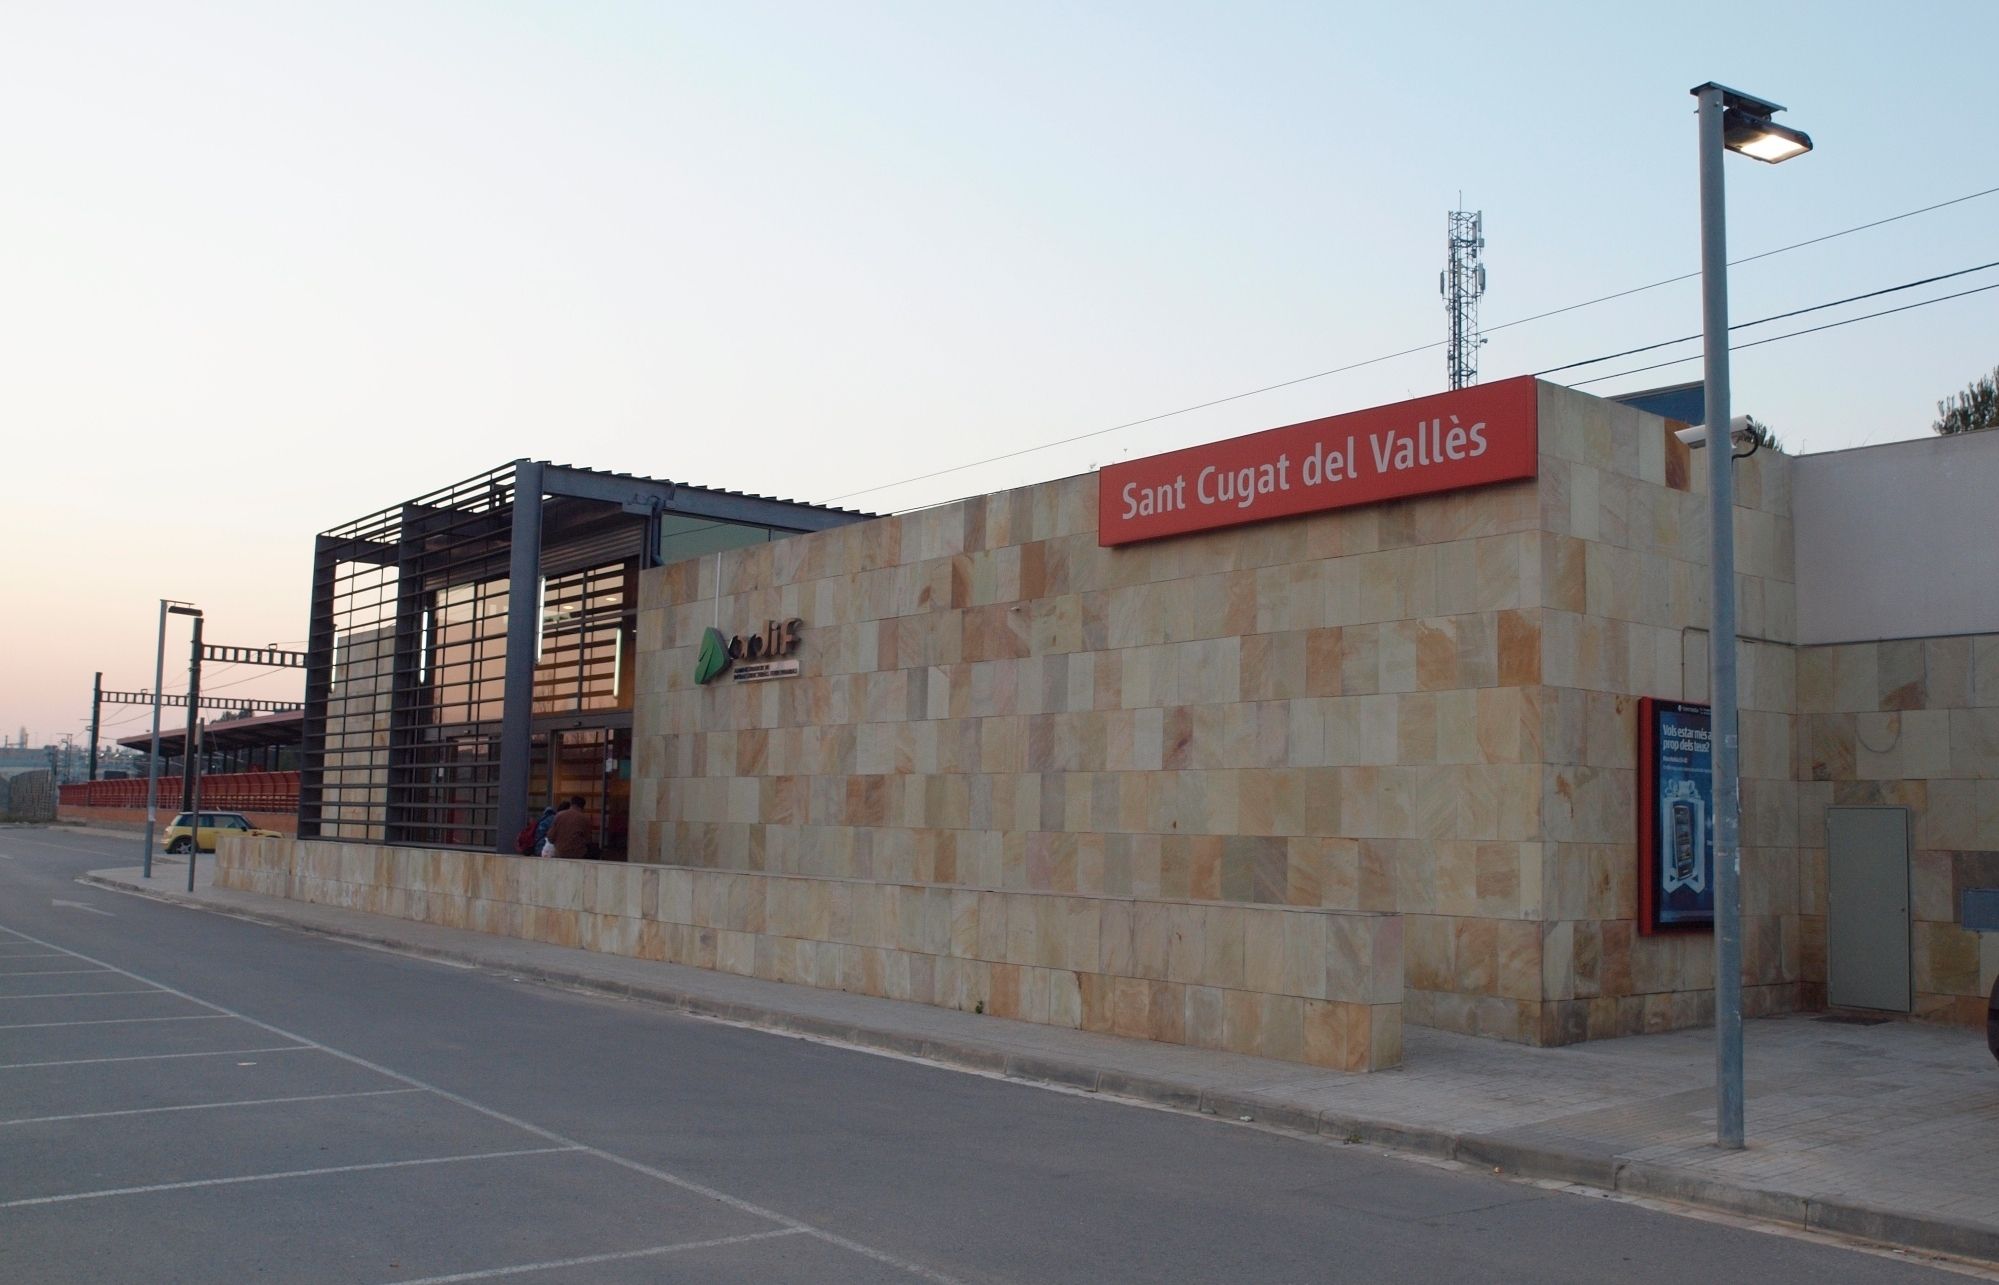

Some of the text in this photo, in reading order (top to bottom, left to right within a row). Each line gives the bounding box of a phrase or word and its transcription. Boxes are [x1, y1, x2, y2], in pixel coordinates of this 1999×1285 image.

[1121, 414, 1488, 519] Sant Cugat del Vallès
[1662, 723, 1677, 737] Vols
[1677, 727, 1693, 738] estar
[1694, 728, 1707, 740] més
[1662, 739, 1679, 752] prop
[1680, 738, 1694, 751] dels
